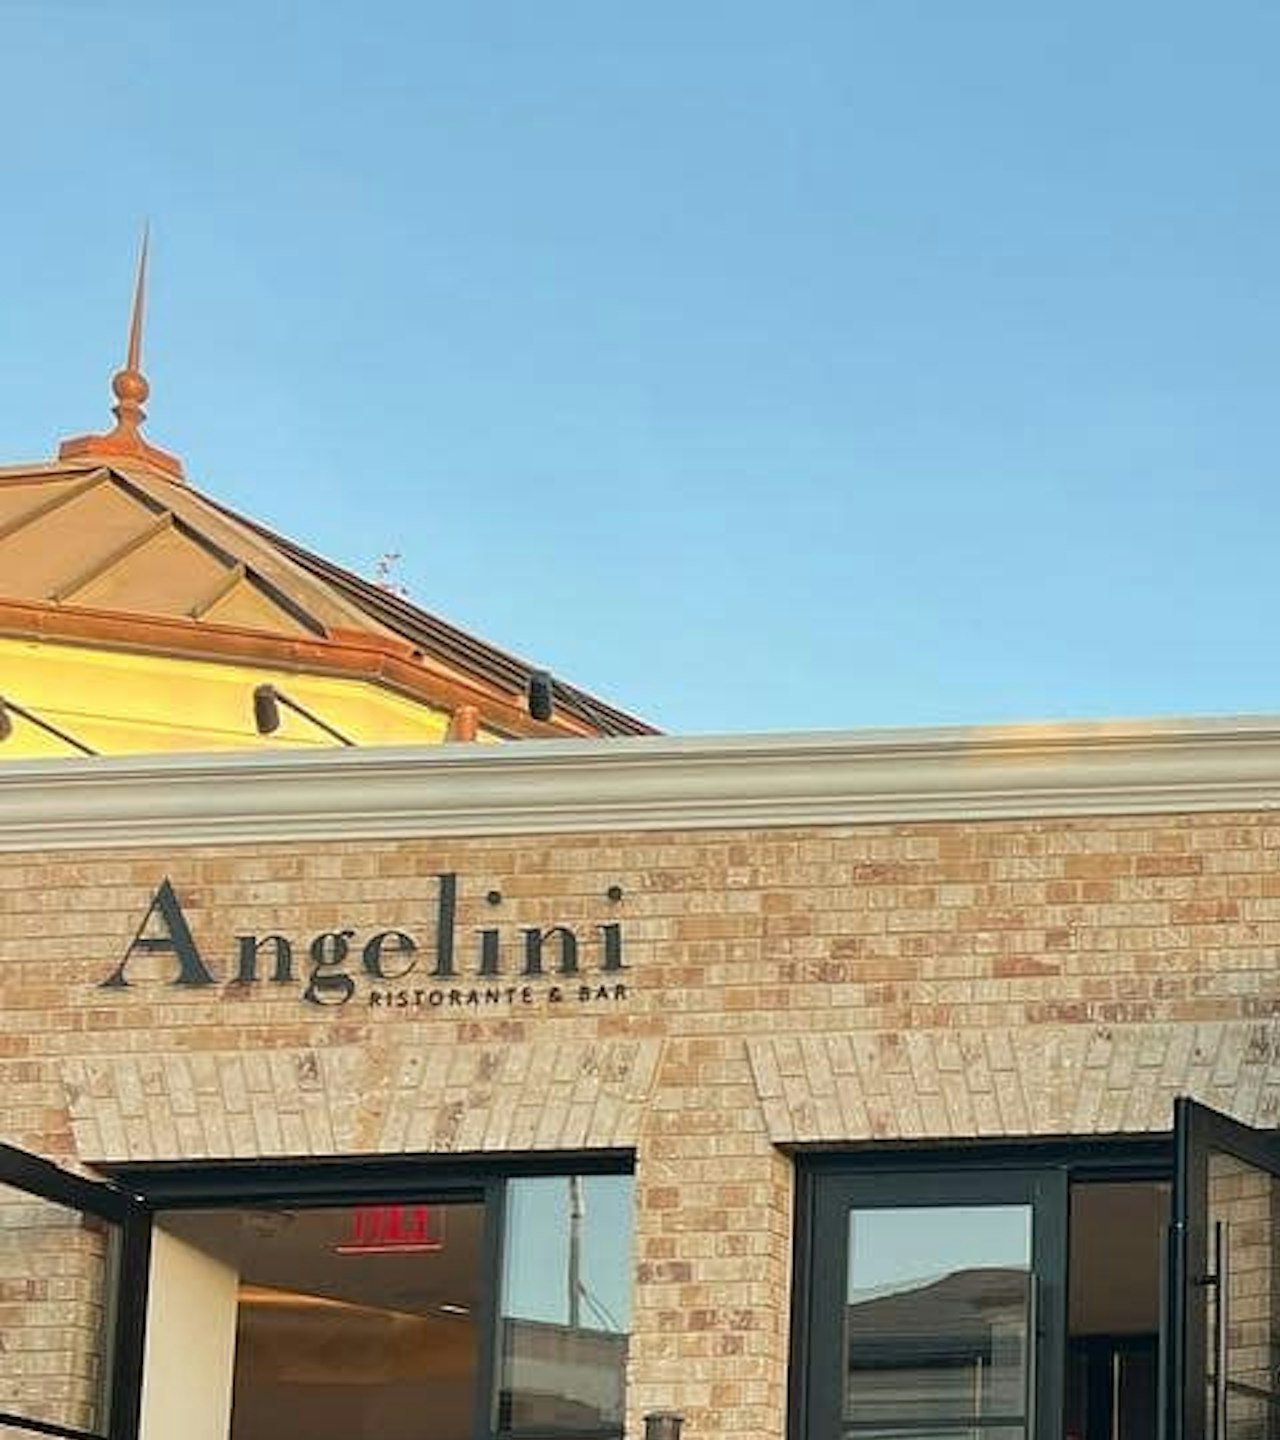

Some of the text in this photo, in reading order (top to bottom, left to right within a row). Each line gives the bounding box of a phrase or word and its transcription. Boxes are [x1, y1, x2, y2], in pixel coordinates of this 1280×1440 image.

[98, 872, 631, 1006] Angelini
[368, 983, 628, 1008] RISTORANTE & BAR
